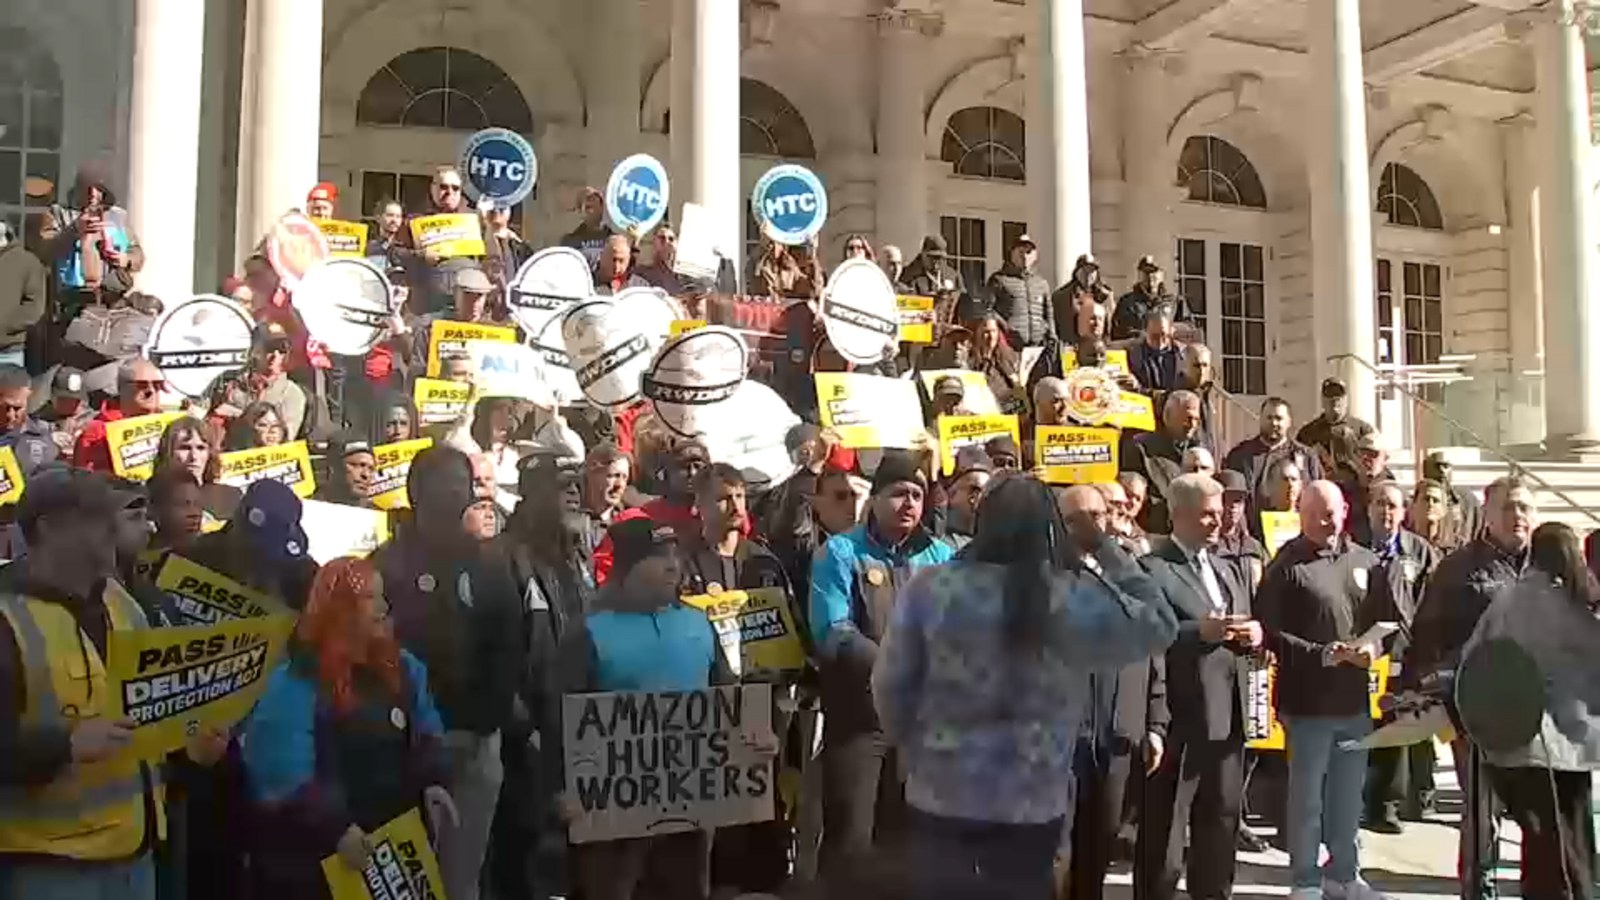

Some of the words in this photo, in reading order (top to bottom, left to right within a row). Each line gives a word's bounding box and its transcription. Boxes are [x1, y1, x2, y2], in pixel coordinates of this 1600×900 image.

[471, 156, 524, 181] HTC
[620, 179, 660, 210] HTC
[766, 193, 817, 218] HTC
[444, 329, 483, 340] PASS
[428, 389, 468, 401] PASS
[122, 421, 162, 441] PASS
[951, 421, 987, 435] PASS
[1047, 433, 1085, 444] PASS
[177, 575, 246, 610] PASS
[706, 599, 747, 617] ASS
[765, 623, 785, 637] ACT
[137, 634, 226, 674] PASS
[126, 645, 266, 704] DELIVERY
[129, 677, 231, 723] PROTECTION
[232, 664, 261, 690] ACT
[576, 686, 742, 741] AMAZON
[606, 730, 729, 776] HURTS
[576, 763, 769, 813] WORKERS
